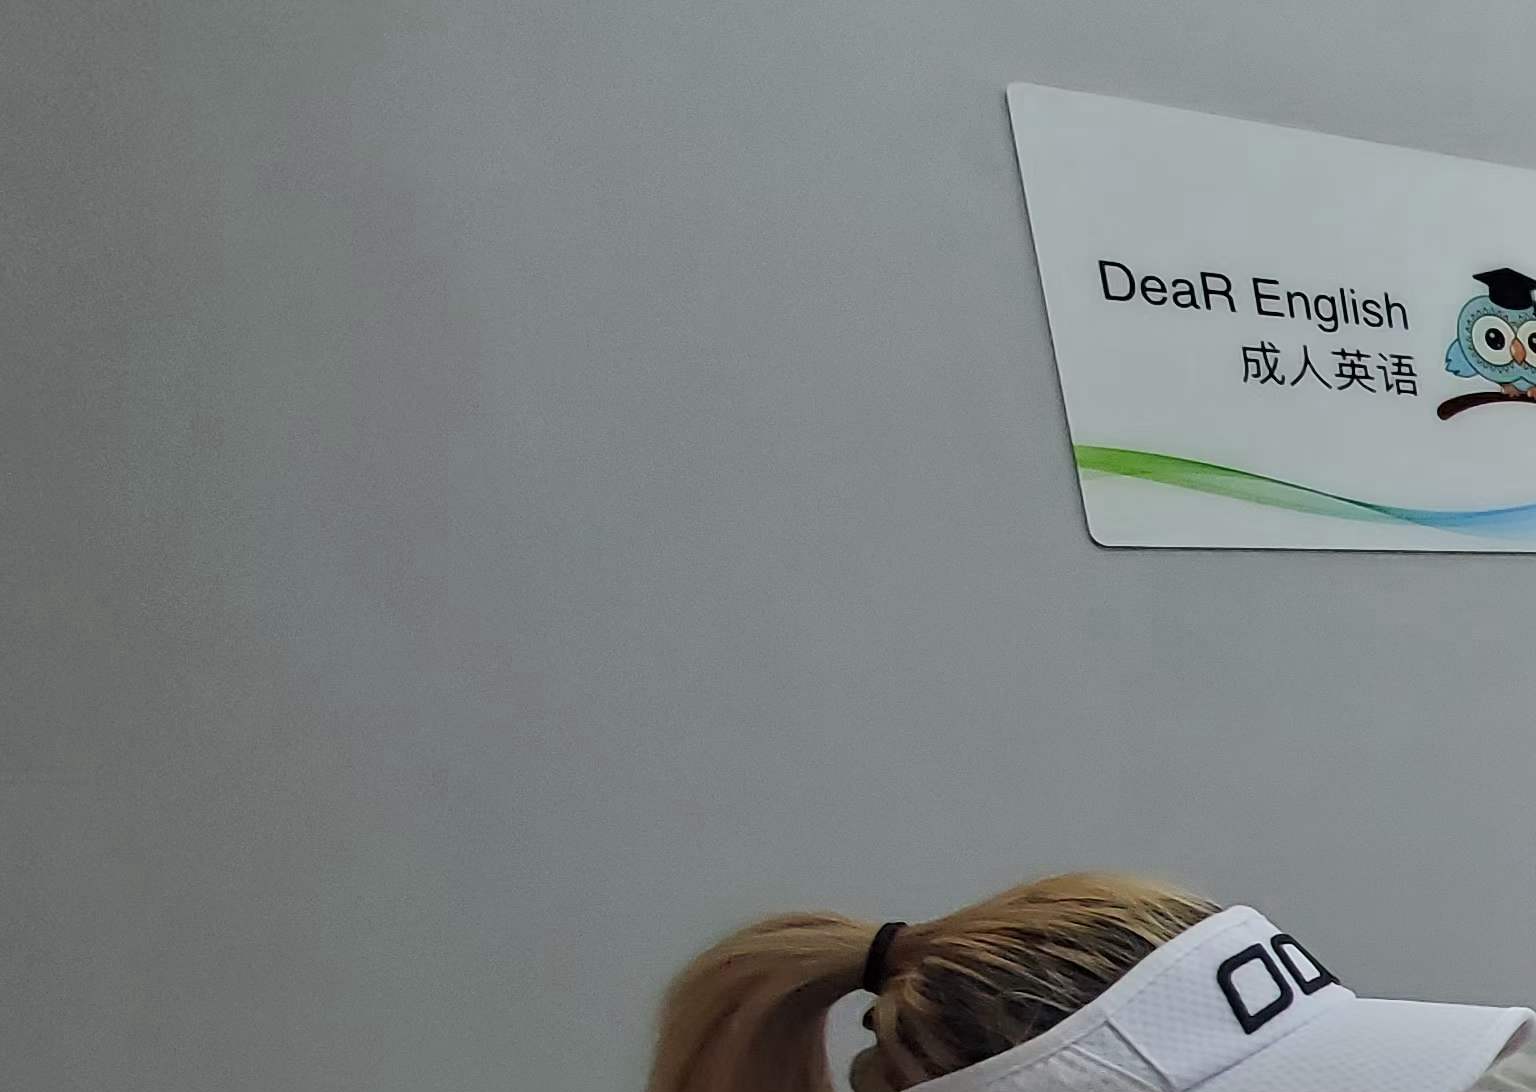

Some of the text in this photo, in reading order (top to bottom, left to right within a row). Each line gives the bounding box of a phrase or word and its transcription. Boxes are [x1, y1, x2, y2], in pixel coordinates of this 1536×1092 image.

[1098, 260, 1410, 332] DeaR English
[1241, 340, 1419, 397] 成人英语
